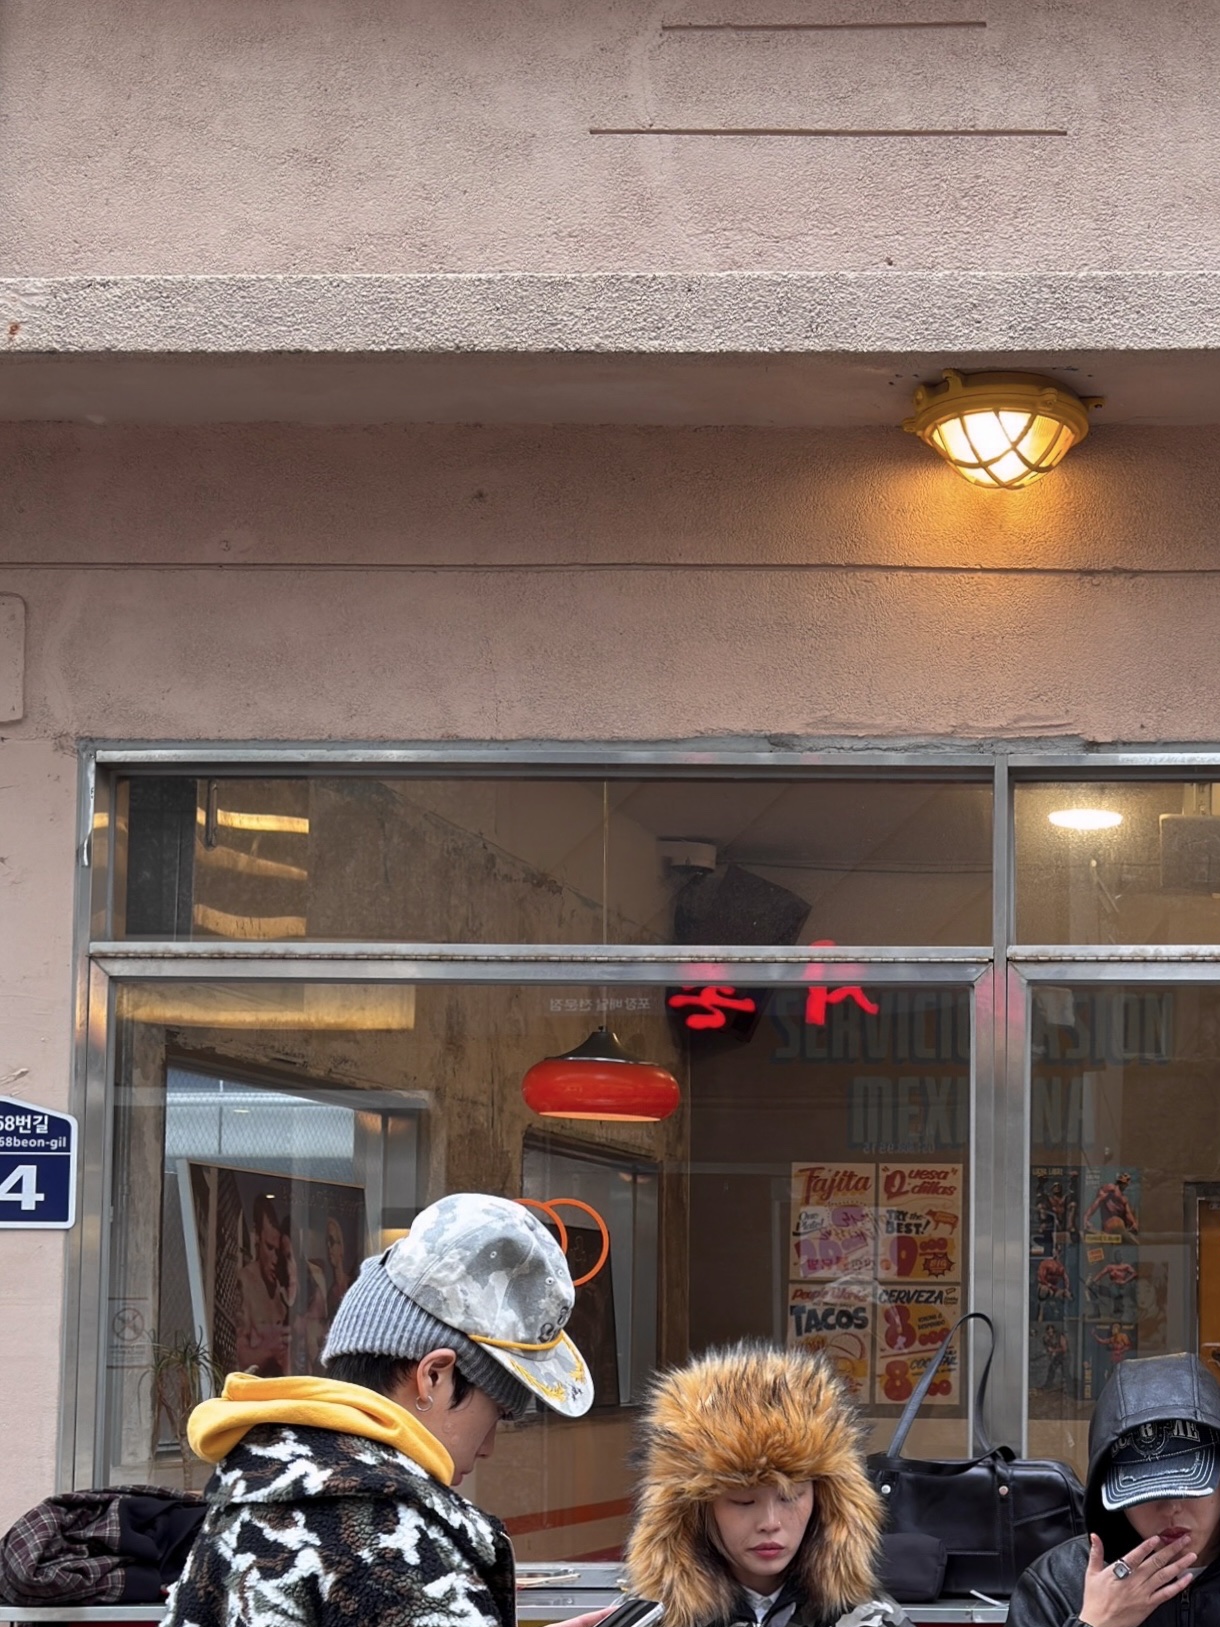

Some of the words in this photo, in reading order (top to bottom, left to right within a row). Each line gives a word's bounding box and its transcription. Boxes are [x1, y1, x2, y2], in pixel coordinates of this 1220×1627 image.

[0, 1164, 45, 1210] 4
[796, 1166, 872, 1205] Fajita
[885, 1209, 906, 1221] TRY
[885, 1219, 931, 1235] BEST!
[878, 1289, 944, 1305] CERVEZA
[790, 1305, 869, 1336] TACOS
